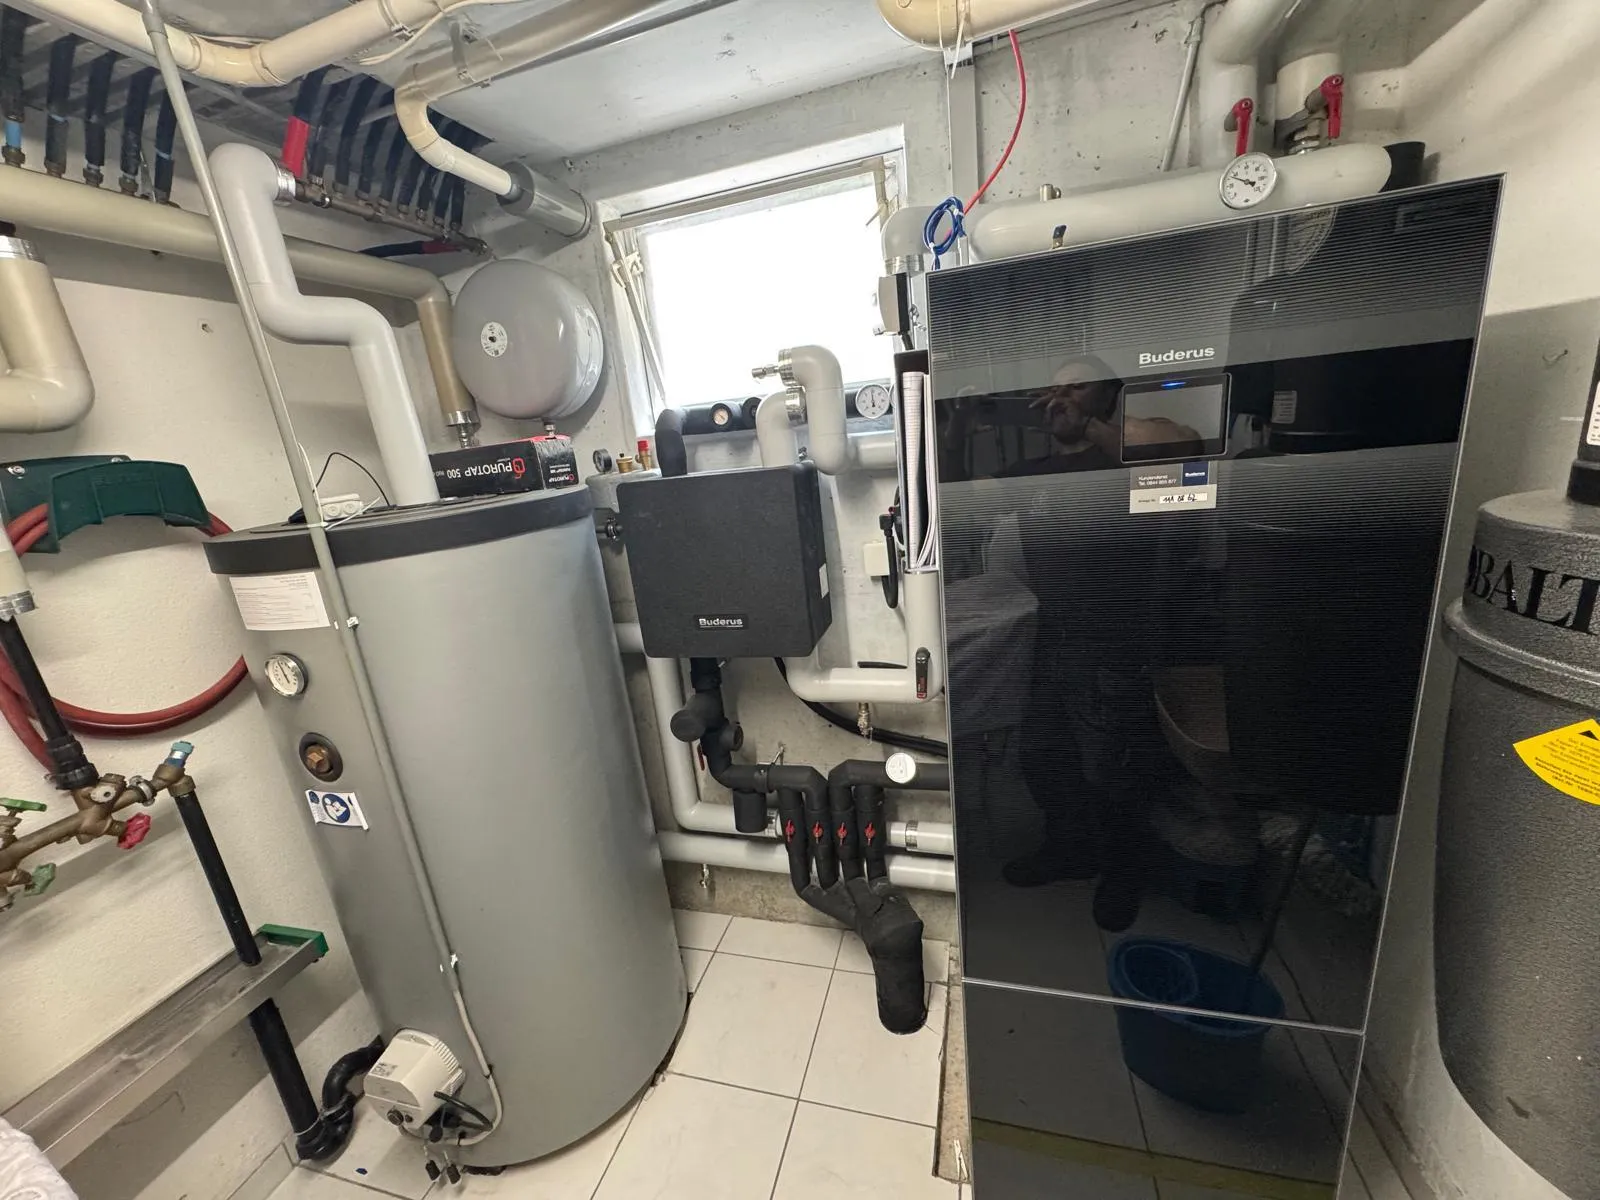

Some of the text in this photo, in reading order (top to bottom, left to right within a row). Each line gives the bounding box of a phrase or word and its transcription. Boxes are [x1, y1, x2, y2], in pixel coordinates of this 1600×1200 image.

[1138, 347, 1215, 365] Buderus
[447, 468, 462, 479] 500
[464, 461, 512, 477] PUROTAP
[698, 618, 743, 626] Buderus
